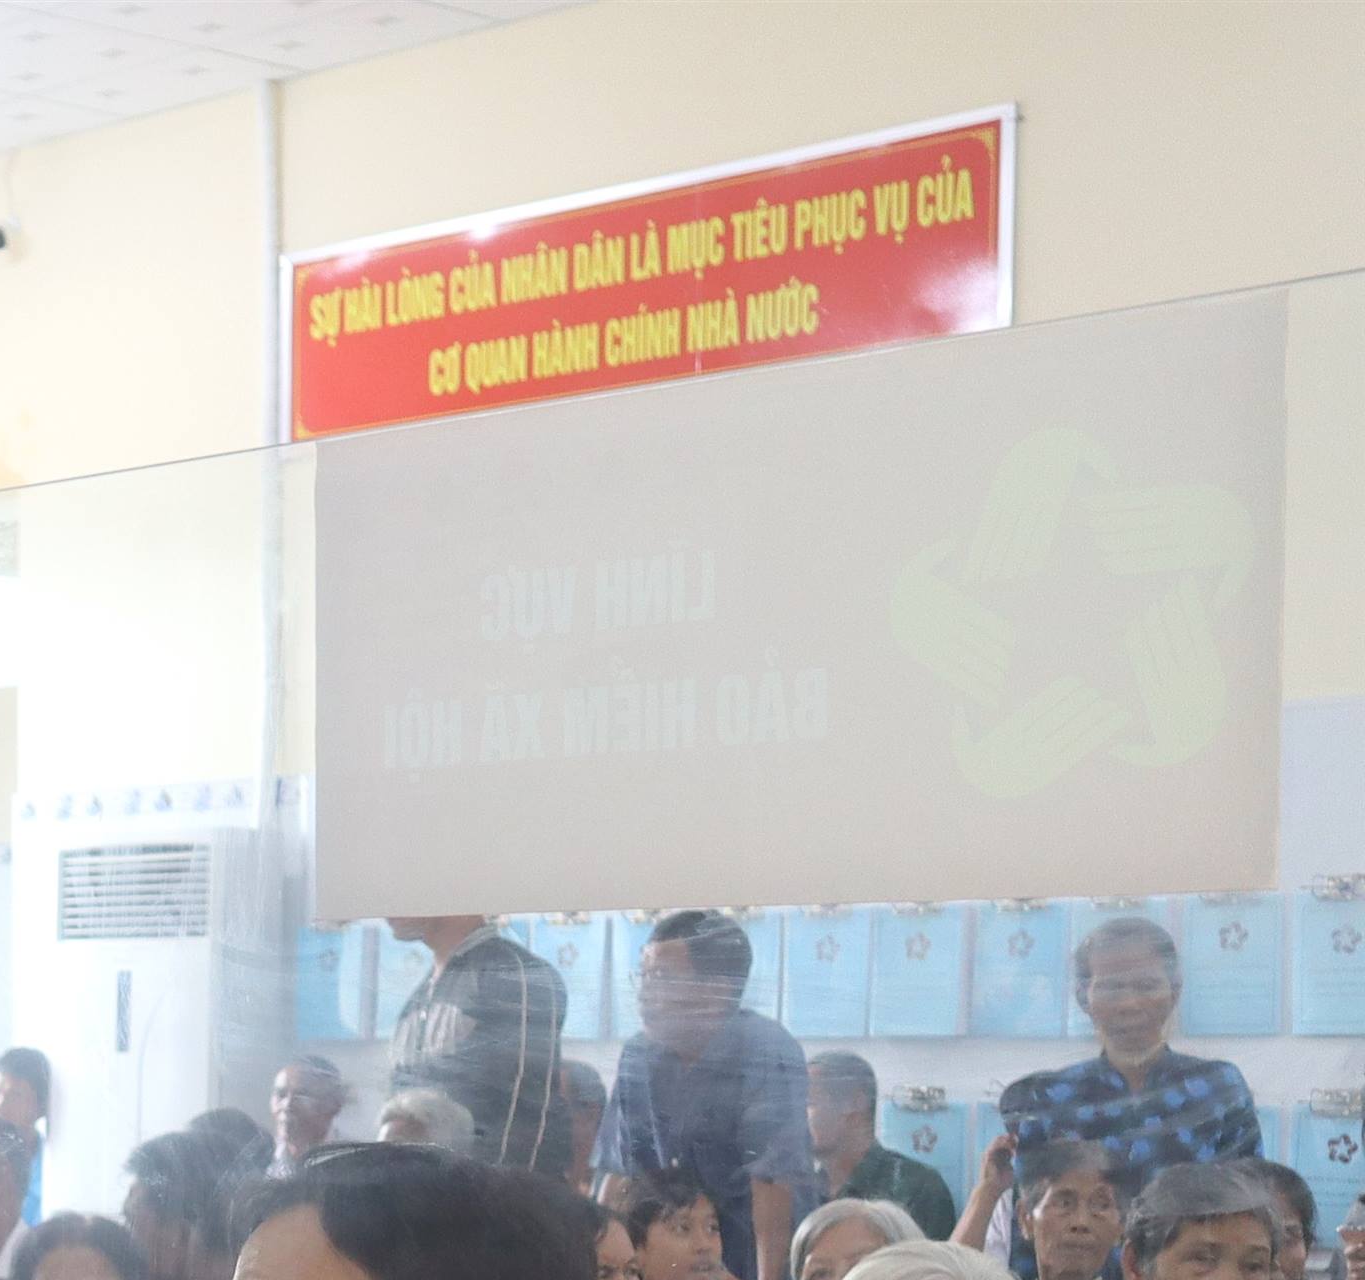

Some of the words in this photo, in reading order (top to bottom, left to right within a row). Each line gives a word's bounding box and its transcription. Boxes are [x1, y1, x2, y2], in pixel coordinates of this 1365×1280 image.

[309, 287, 342, 347] SỰ
[344, 276, 382, 334] HÀI
[385, 266, 446, 327] LÒNG
[449, 248, 497, 314] CỦA
[501, 240, 568, 304] NHÂN
[573, 229, 625, 292] DÂN
[630, 219, 662, 281] LÀ
[667, 216, 725, 280] MỤC
[730, 197, 788, 263] TIÊU
[793, 188, 867, 255] PHỤC
[872, 180, 910, 245] VỤ
[916, 154, 975, 229] CỦA
[428, 340, 462, 396] CƠ
[465, 333, 528, 394] QUAN
[533, 319, 600, 380] HÀNH
[605, 302, 682, 367] CHÍNH
[687, 287, 741, 351] NHÀ
[746, 275, 820, 344] NƯỚC
